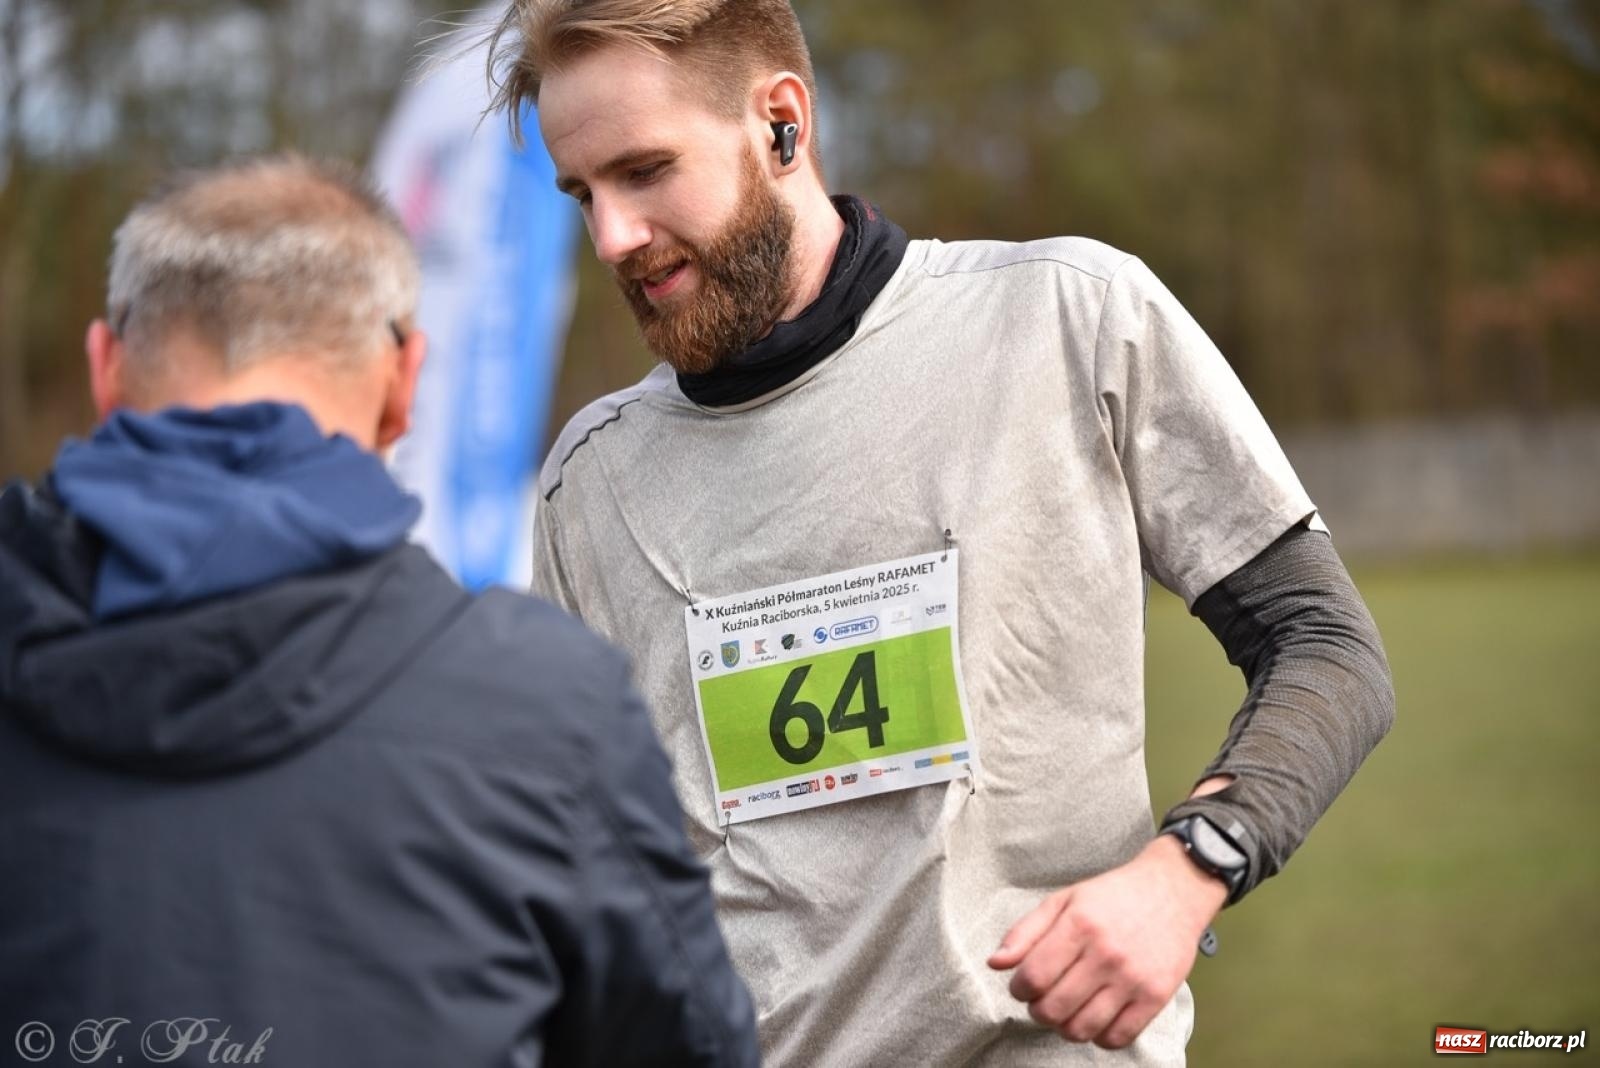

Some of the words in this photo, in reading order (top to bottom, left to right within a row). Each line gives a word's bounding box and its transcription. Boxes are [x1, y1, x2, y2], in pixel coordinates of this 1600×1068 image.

[704, 608, 715, 620] X
[715, 595, 776, 618] Kuźniański
[777, 583, 842, 605] Półmaraton
[844, 575, 876, 590] Leśny
[877, 561, 936, 583] RAFAMET
[721, 616, 759, 633] Kuźnia
[760, 604, 822, 625] Raciborska,
[824, 600, 831, 611] 5
[833, 590, 880, 609] kwietnia
[881, 583, 910, 599] 2025
[911, 583, 920, 592] r.
[834, 619, 875, 636] RAFAMET
[769, 650, 890, 765] 64
